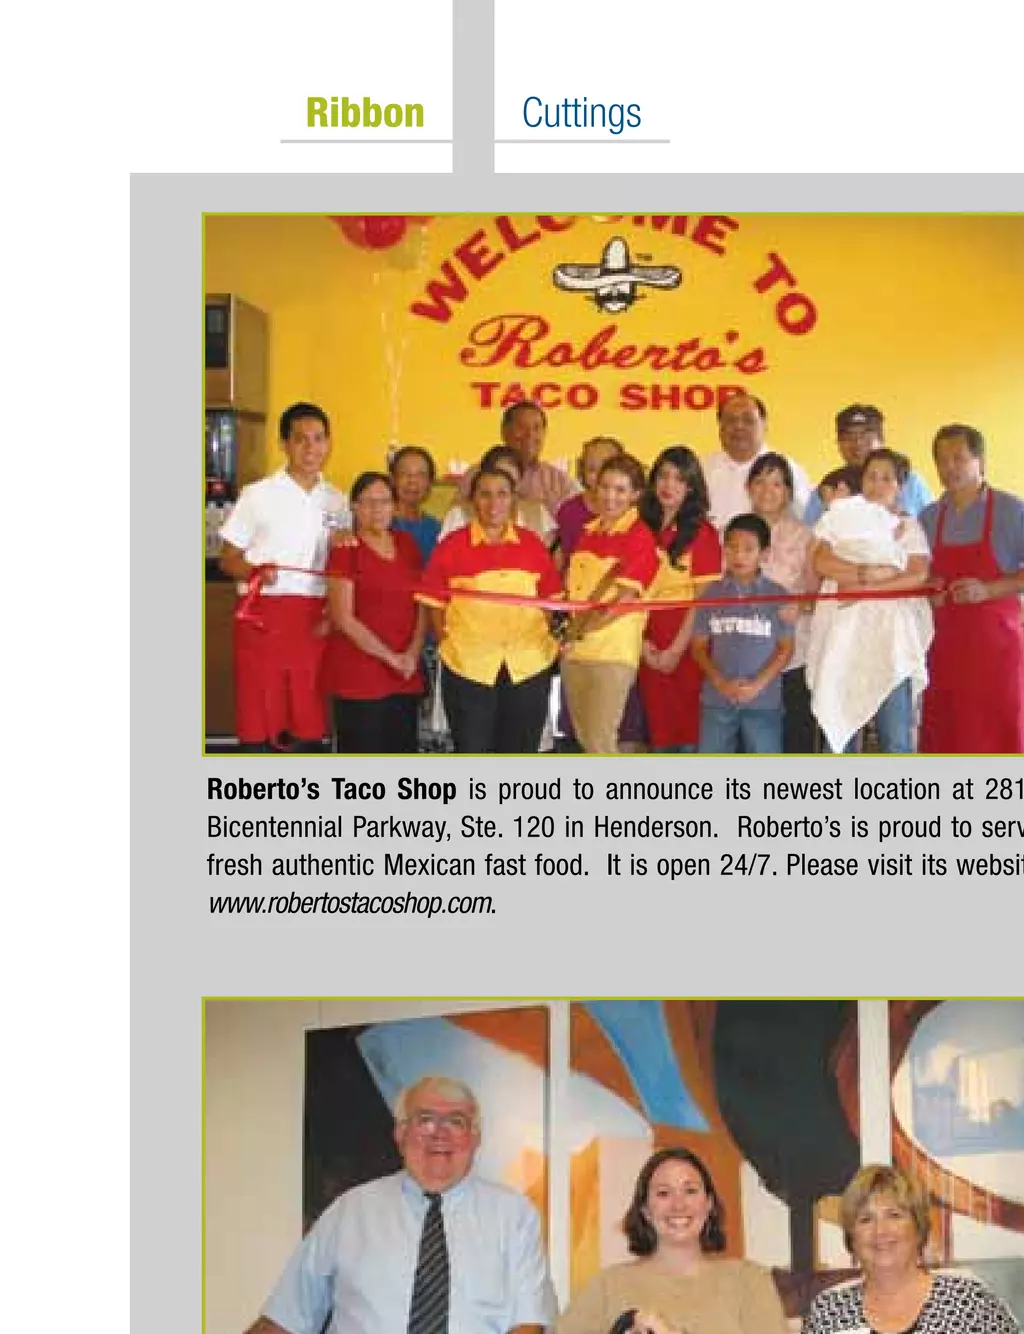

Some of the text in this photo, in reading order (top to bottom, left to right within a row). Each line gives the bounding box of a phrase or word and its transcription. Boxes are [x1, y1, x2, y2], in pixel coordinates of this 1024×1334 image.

[306, 95, 642, 136] Ribbon Cuttings
[753, 252, 819, 335] TO
[459, 314, 768, 374] Roberto's
[471, 381, 599, 411] TACO
[207, 777, 320, 801] Roberto's
[330, 777, 386, 801] Taco
[397, 776, 457, 805] Shop
[469, 777, 487, 801] is
[498, 777, 561, 805] proud
[572, 777, 594, 801] to
[605, 782, 714, 801] announce
[725, 777, 751, 801] its
[763, 777, 843, 801] newest
[854, 777, 940, 801] location
[952, 777, 975, 801] at
[207, 815, 342, 839] Bicentennial
[353, 815, 451, 843] Parkway,
[460, 814, 503, 838] Ste.
[513, 815, 555, 838] 120
[565, 815, 584, 838] in
[594, 815, 719, 839] Henderson.
[738, 815, 841, 839] Roberto's
[851, 815, 869, 838] is
[879, 815, 941, 843] proud
[950, 815, 972, 839] to
[209, 891, 496, 919] www.robertostacoshop.com.
